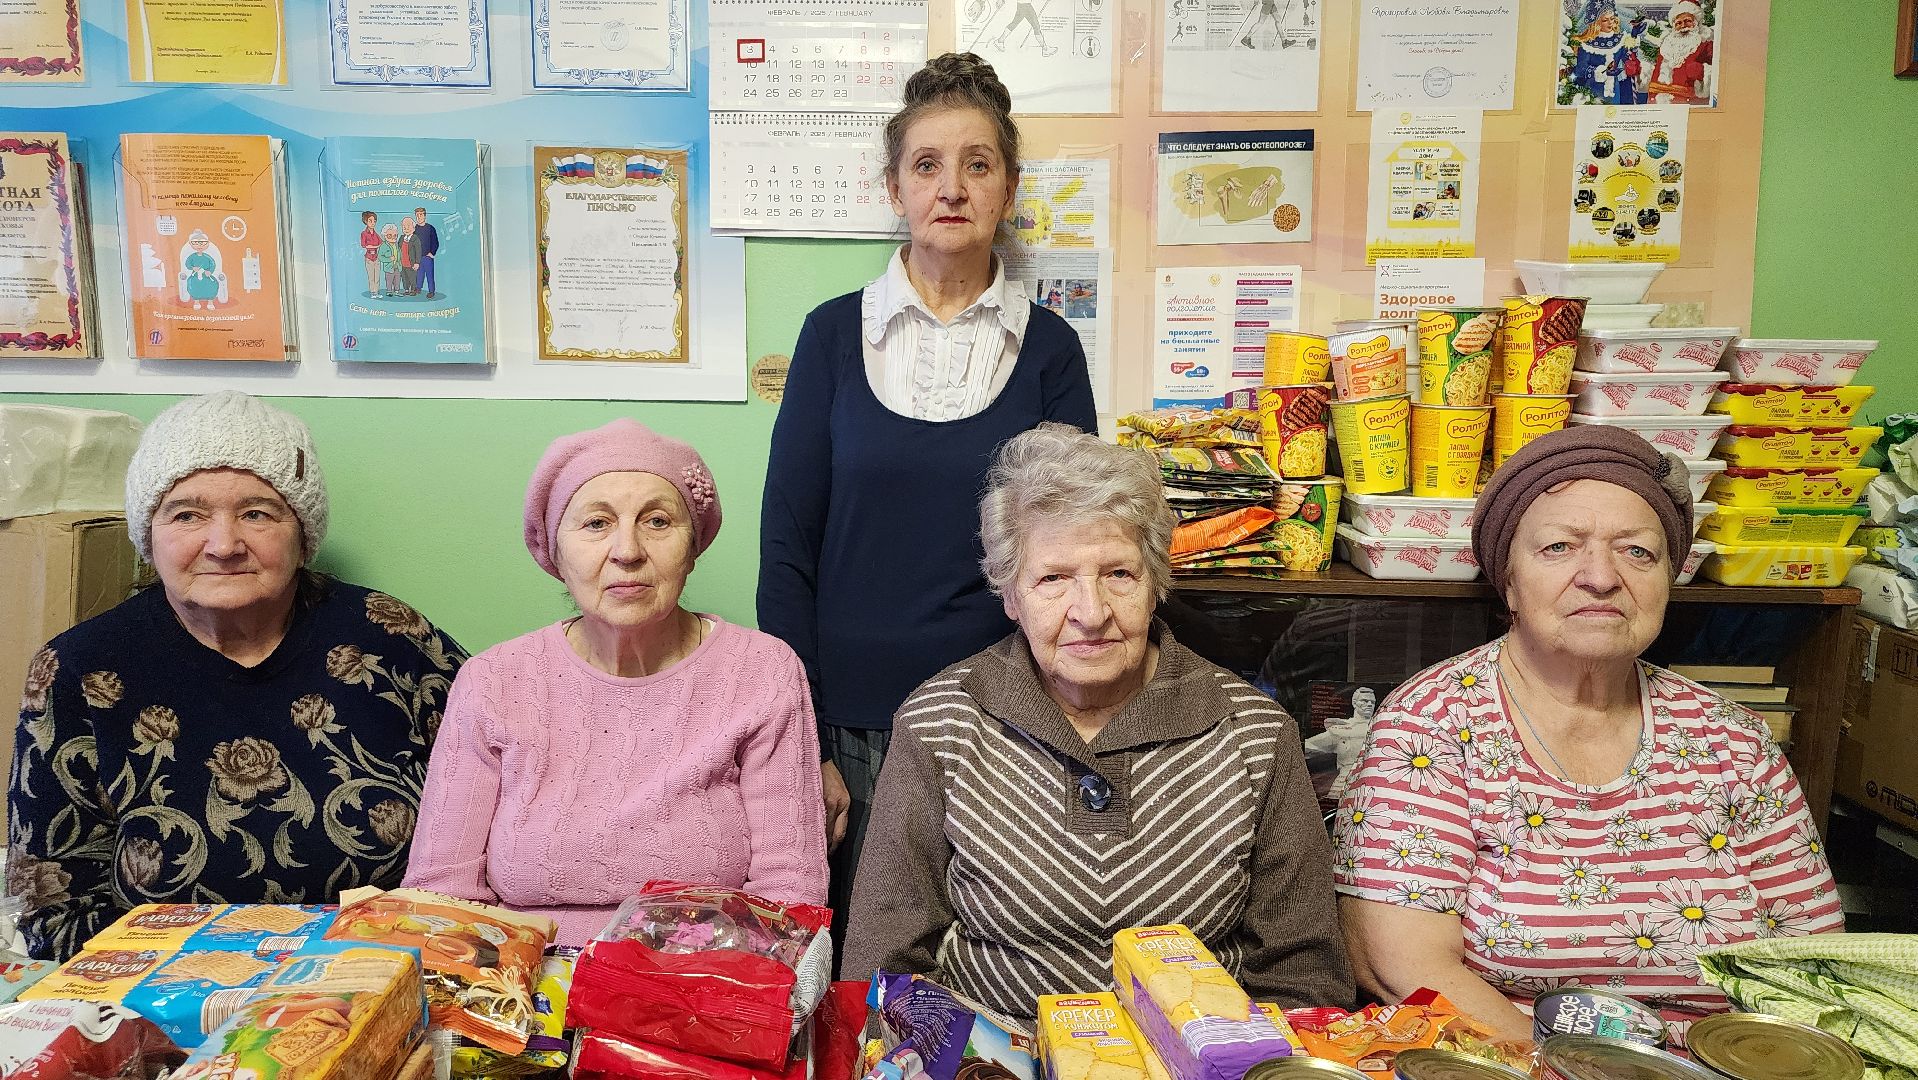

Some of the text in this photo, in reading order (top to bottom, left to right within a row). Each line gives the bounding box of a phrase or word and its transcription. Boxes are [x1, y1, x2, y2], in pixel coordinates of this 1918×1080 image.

[767, 9, 801, 17] ФЕВРАЛЬ
[835, 10, 873, 18] FEBRUARY
[883, 32, 890, 41] 2
[746, 45, 754, 54] 3
[768, 45, 776, 54] 4
[792, 45, 799, 54] 5
[814, 45, 822, 54] 6
[860, 46, 867, 55] 8
[883, 46, 890, 55] 9
[766, 60, 779, 69] 11
[789, 60, 802, 69] 12
[811, 60, 825, 69] 13
[834, 60, 848, 69] 14
[857, 61, 871, 70] 15
[881, 61, 894, 71] 16
[744, 75, 894, 85] 17 18 19 20 21 22 23
[743, 89, 848, 98] 24 25 26 27 28
[767, 130, 801, 138] ФЕВРАЛЬ
[834, 131, 873, 139] FEBRUARY
[1167, 141, 1306, 151] ЧТО СЛЕДУЕТ ЗНАТЬ ОБ ОСТЕОПОРОЗЕ?
[747, 165, 867, 175] 3 4 5 6 7 8
[383, 176, 411, 188] азбука
[412, 178, 453, 193] здоровья
[744, 180, 870, 189] 10 11 12 13 14 15
[351, 189, 448, 203] для пожилого человека
[565, 192, 657, 202] БЛАГОДАРСТВЕННОЕ
[745, 194, 757, 203] 17
[767, 194, 780, 203] 18
[789, 194, 802, 203] 19
[811, 194, 825, 203] 20
[833, 194, 846, 203] 21
[856, 195, 870, 204] 22
[0, 200, 35, 211] ОТА
[587, 203, 636, 212] ПИСЬМО
[743, 207, 848, 218] 24 25 26 27 28
[1167, 295, 1215, 305] Активное
[1380, 293, 1455, 306] Здоровое
[1167, 305, 1216, 313] долголетие
[395, 310, 426, 321] четыре
[1380, 310, 1417, 319] долг
[1505, 310, 1539, 323] оллтон
[1418, 322, 1452, 335] оллтон
[1309, 351, 1331, 361] Роллт
[1369, 433, 1391, 443] ЛАПША
[134, 914, 207, 924] КАРУСЕЛИ
[1134, 937, 1199, 953] КРЕКЕР
[1153, 949, 1204, 958] КУНЖУТОМ
[69, 960, 153, 974] КАРУСЕЛИ
[1051, 1008, 1116, 1022] КРЕКЕР
[1064, 1022, 1119, 1031] КУНЖУТОМ
